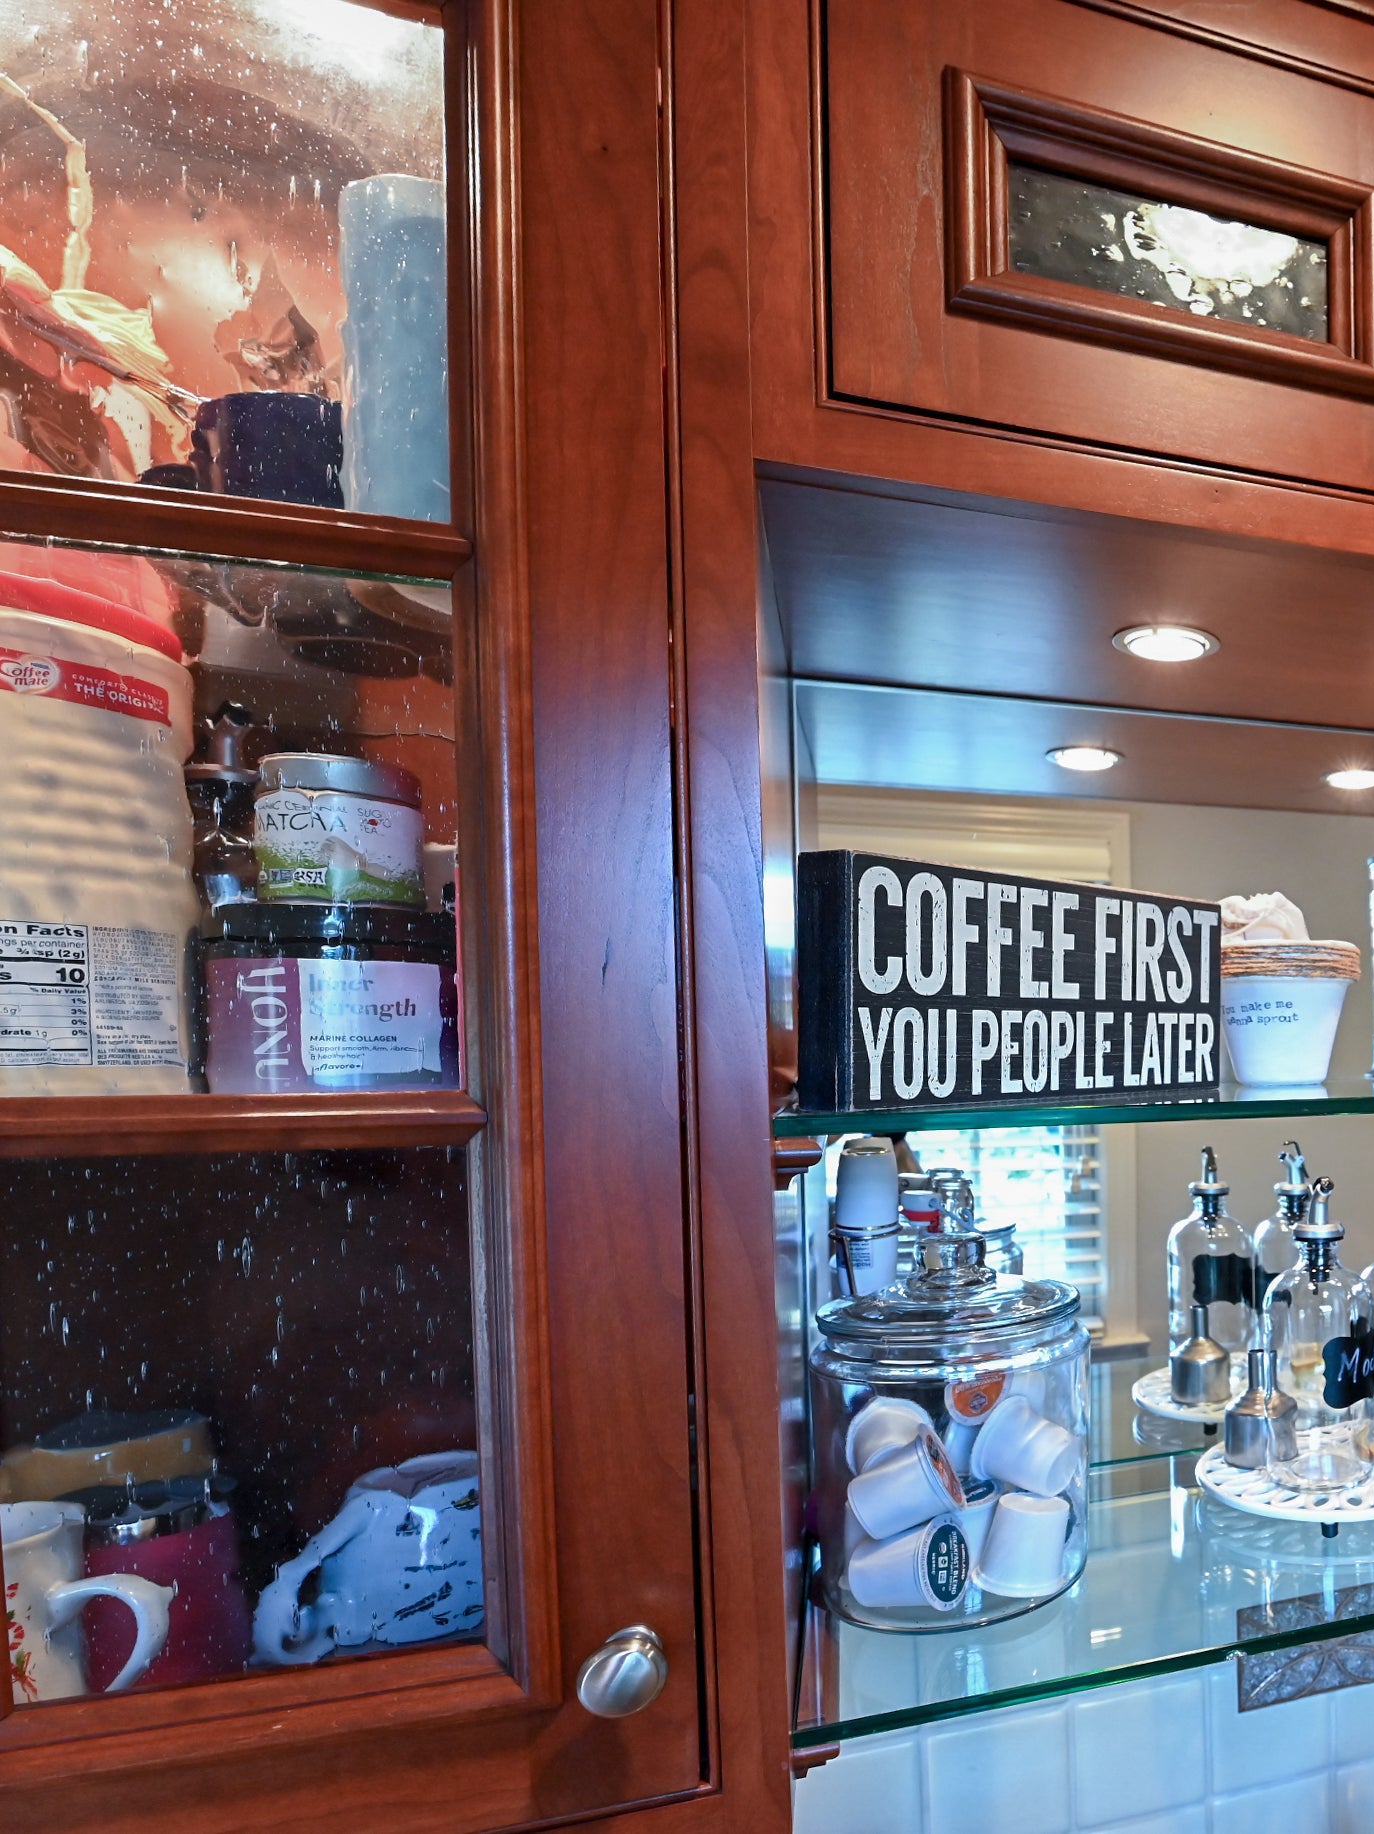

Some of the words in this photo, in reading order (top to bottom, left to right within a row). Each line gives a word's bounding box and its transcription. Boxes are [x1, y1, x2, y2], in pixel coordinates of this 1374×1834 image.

[74, 683, 104, 698] THE
[27, 925, 85, 938] Facts
[858, 866, 1080, 999] COFFEE
[1094, 896, 1218, 1004] FIRST
[39, 940, 85, 949] container
[56, 967, 85, 983] 10
[309, 973, 373, 993] Inner
[309, 998, 416, 1023] Strength
[1241, 1002, 1271, 1012] make
[1275, 1000, 1293, 1009] me
[244, 966, 290, 1080] HONU
[1257, 1013, 1299, 1025] sprout
[349, 1035, 397, 1043] COLLAGEN
[309, 1045, 340, 1053] Support
[858, 1007, 957, 1100] YOU
[971, 1009, 1114, 1095] PEOPLE
[1123, 1012, 1215, 1086] LATER
[312, 1063, 364, 1072] nflavore
[951, 1531, 960, 1568] BREAKFAST
[950, 1570, 959, 1595] BLEND
